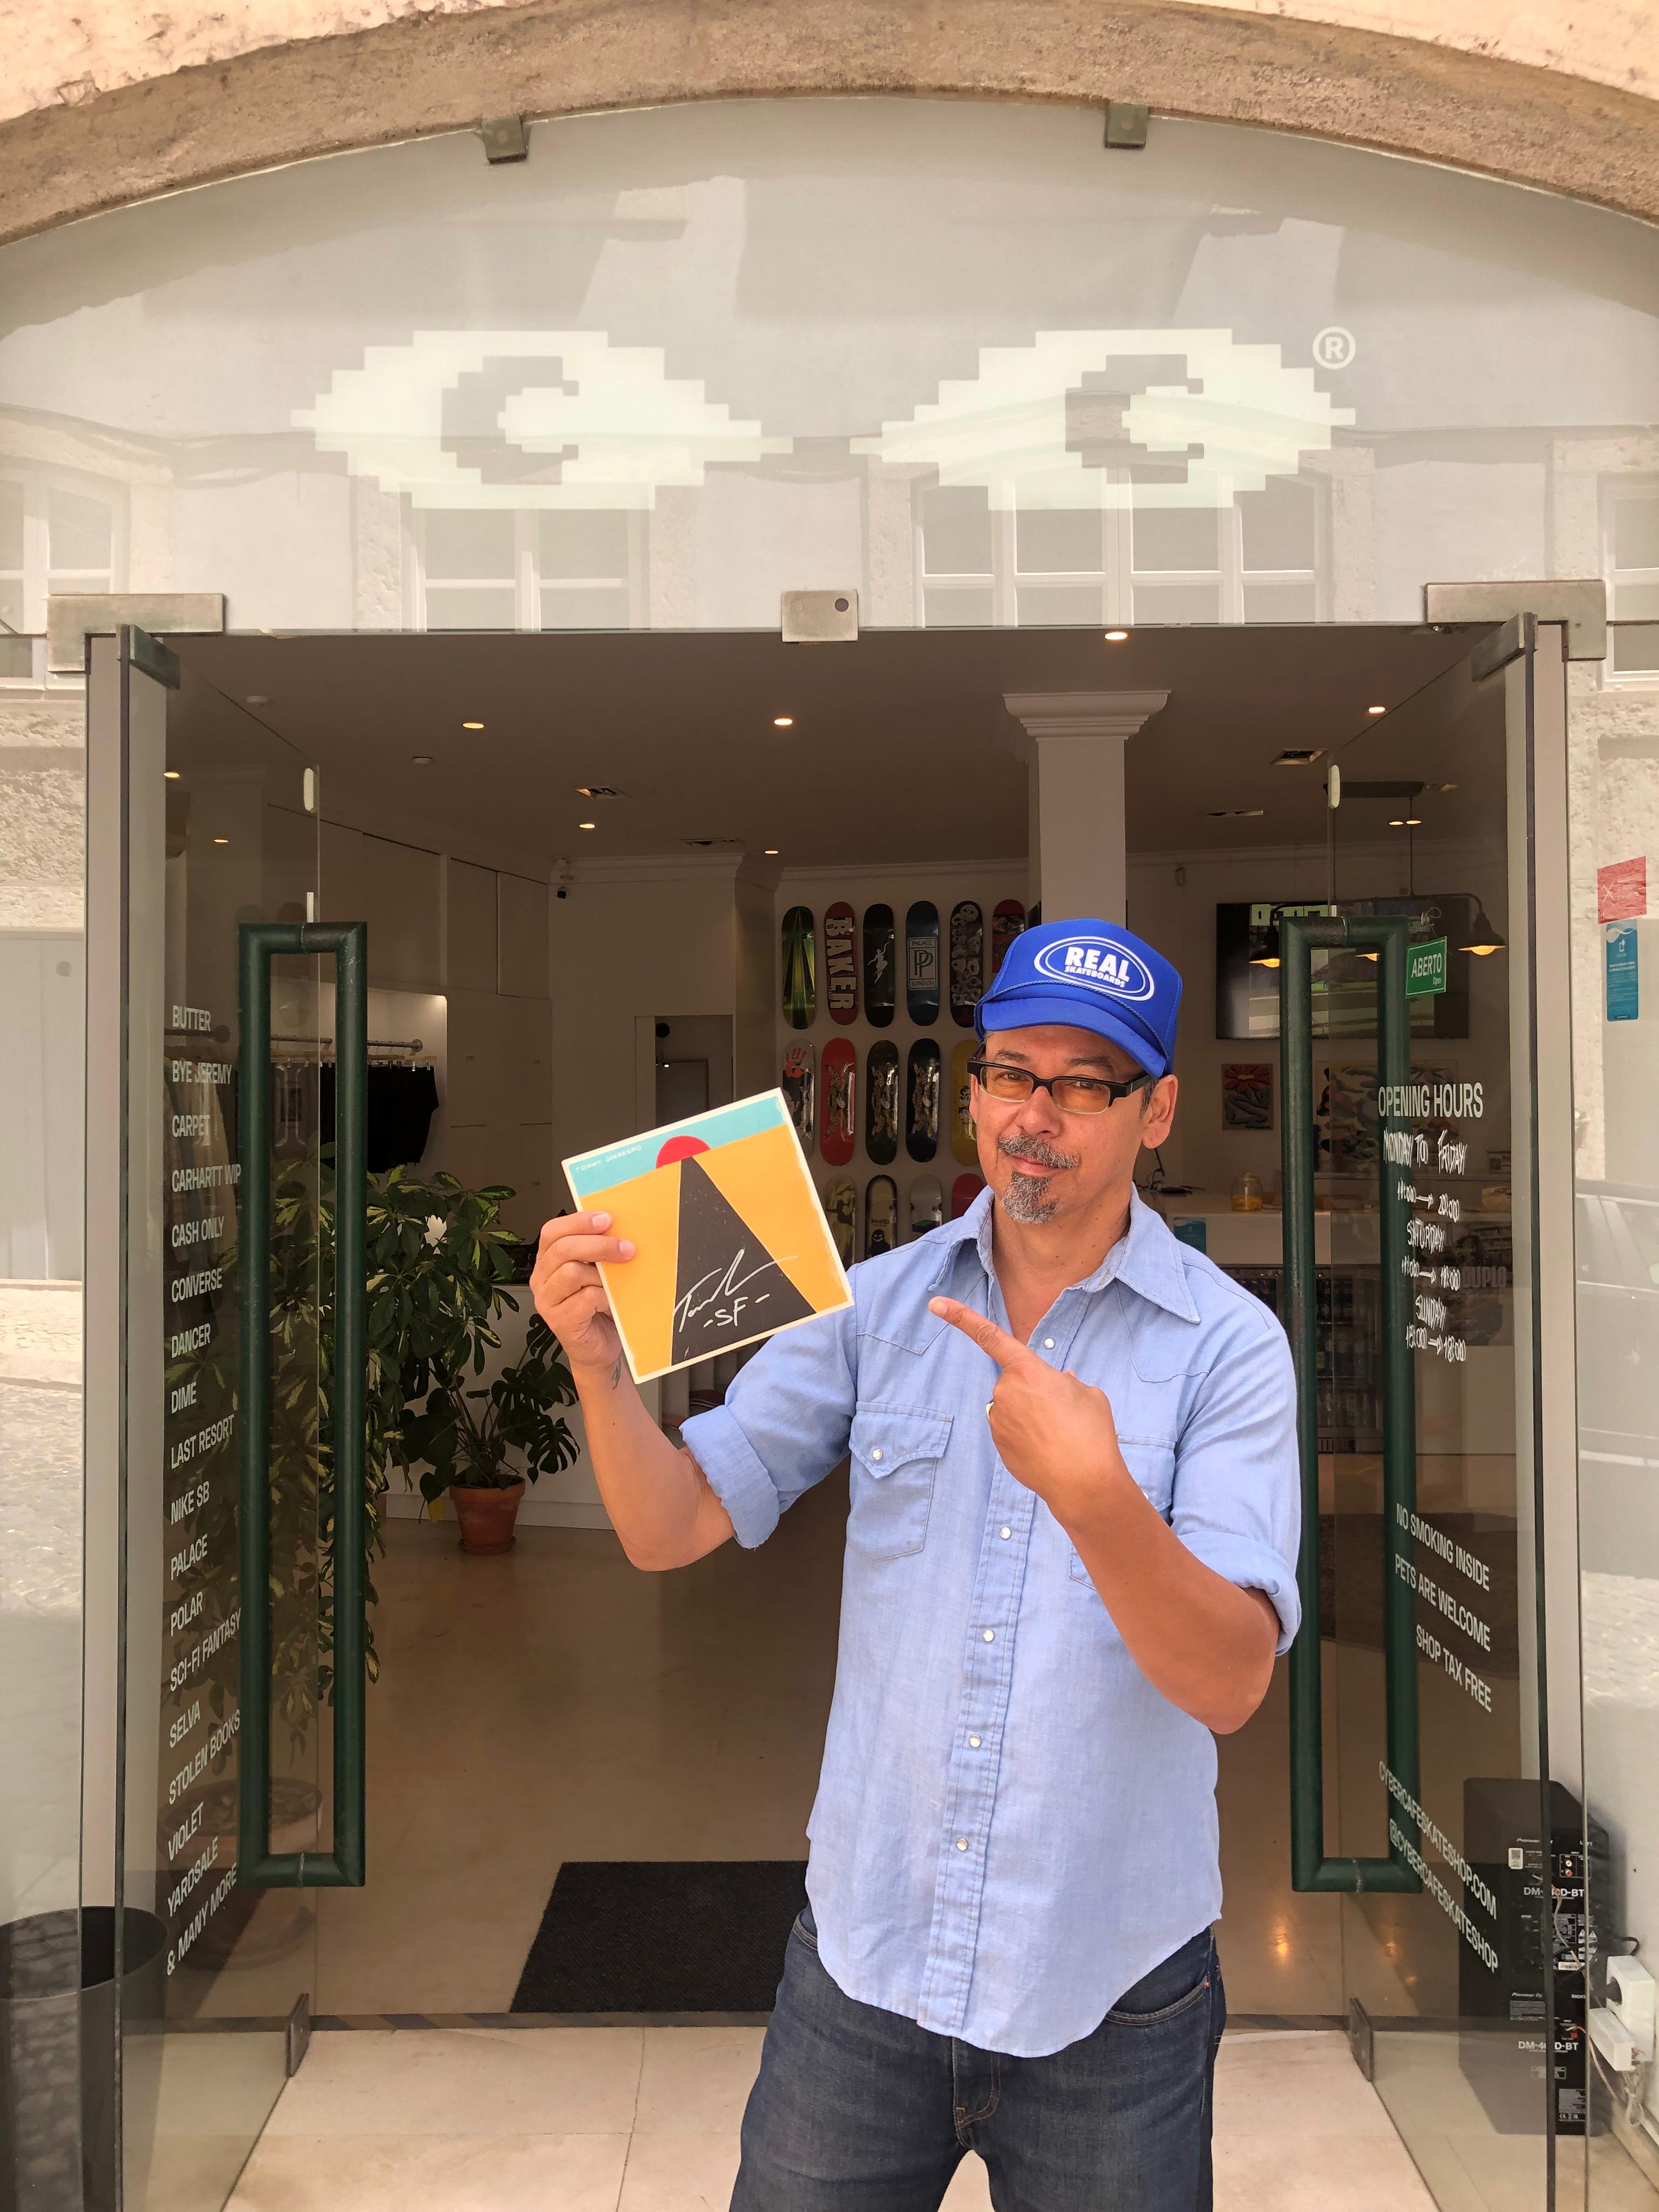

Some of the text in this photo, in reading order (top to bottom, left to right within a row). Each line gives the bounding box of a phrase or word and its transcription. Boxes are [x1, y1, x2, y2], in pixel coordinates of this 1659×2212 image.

[825, 917, 856, 1009] BAKER
[1064, 946, 1130, 983] REAL
[1064, 964, 1126, 988] SKATEBOARDS
[1411, 952, 1442, 978] ABERTO
[1432, 977, 1442, 986] Open
[172, 1005, 211, 1031] BUTTER
[172, 1060, 233, 1085] BYE JEREMY
[1378, 1082, 1483, 1118] OPENING HOURS
[172, 1115, 211, 1138] CARPET
[574, 1145, 642, 1173] TOMMY GUERRERO
[1383, 1127, 1414, 1169] MONDAY
[1437, 1129, 1468, 1175] FRIDAY
[172, 1164, 241, 1193] CARHARTT WIP
[172, 1216, 225, 1248] CASH ONLY
[1406, 1217, 1445, 1254] SATURDAY
[171, 1267, 223, 1303] CONVERSE
[1415, 1294, 1447, 1331] SUNDAY
[171, 1322, 211, 1359] DANCER
[171, 1381, 197, 1414] DIME
[171, 1414, 235, 1470] LAST RESORT
[171, 1481, 210, 1526] NIKE SB
[171, 1534, 208, 1582] PALACE
[1396, 1502, 1490, 1592] NO SMOKING INSIDE
[170, 1591, 203, 1637] POLAR
[1395, 1553, 1491, 1652] PETS ARE WELCOME
[170, 1607, 241, 1692] SCI-FI FANTASY
[1415, 1624, 1492, 1713] SHOP TAX FREE
[169, 1700, 201, 1748] SELVA
[169, 1708, 240, 1805] STOLEN BOOKS
[168, 1802, 204, 1861] VIOLET
[1379, 1760, 1497, 1920] CYBERCAFESKATESHOP.COM
[167, 1835, 218, 1917] YARDSALE
[1389, 1818, 1499, 1973] @CYBERCAFESKATESHOP
[167, 1862, 237, 1976] & MANY MORE
[1517, 2040, 1579, 2051] DM-4D-BT
